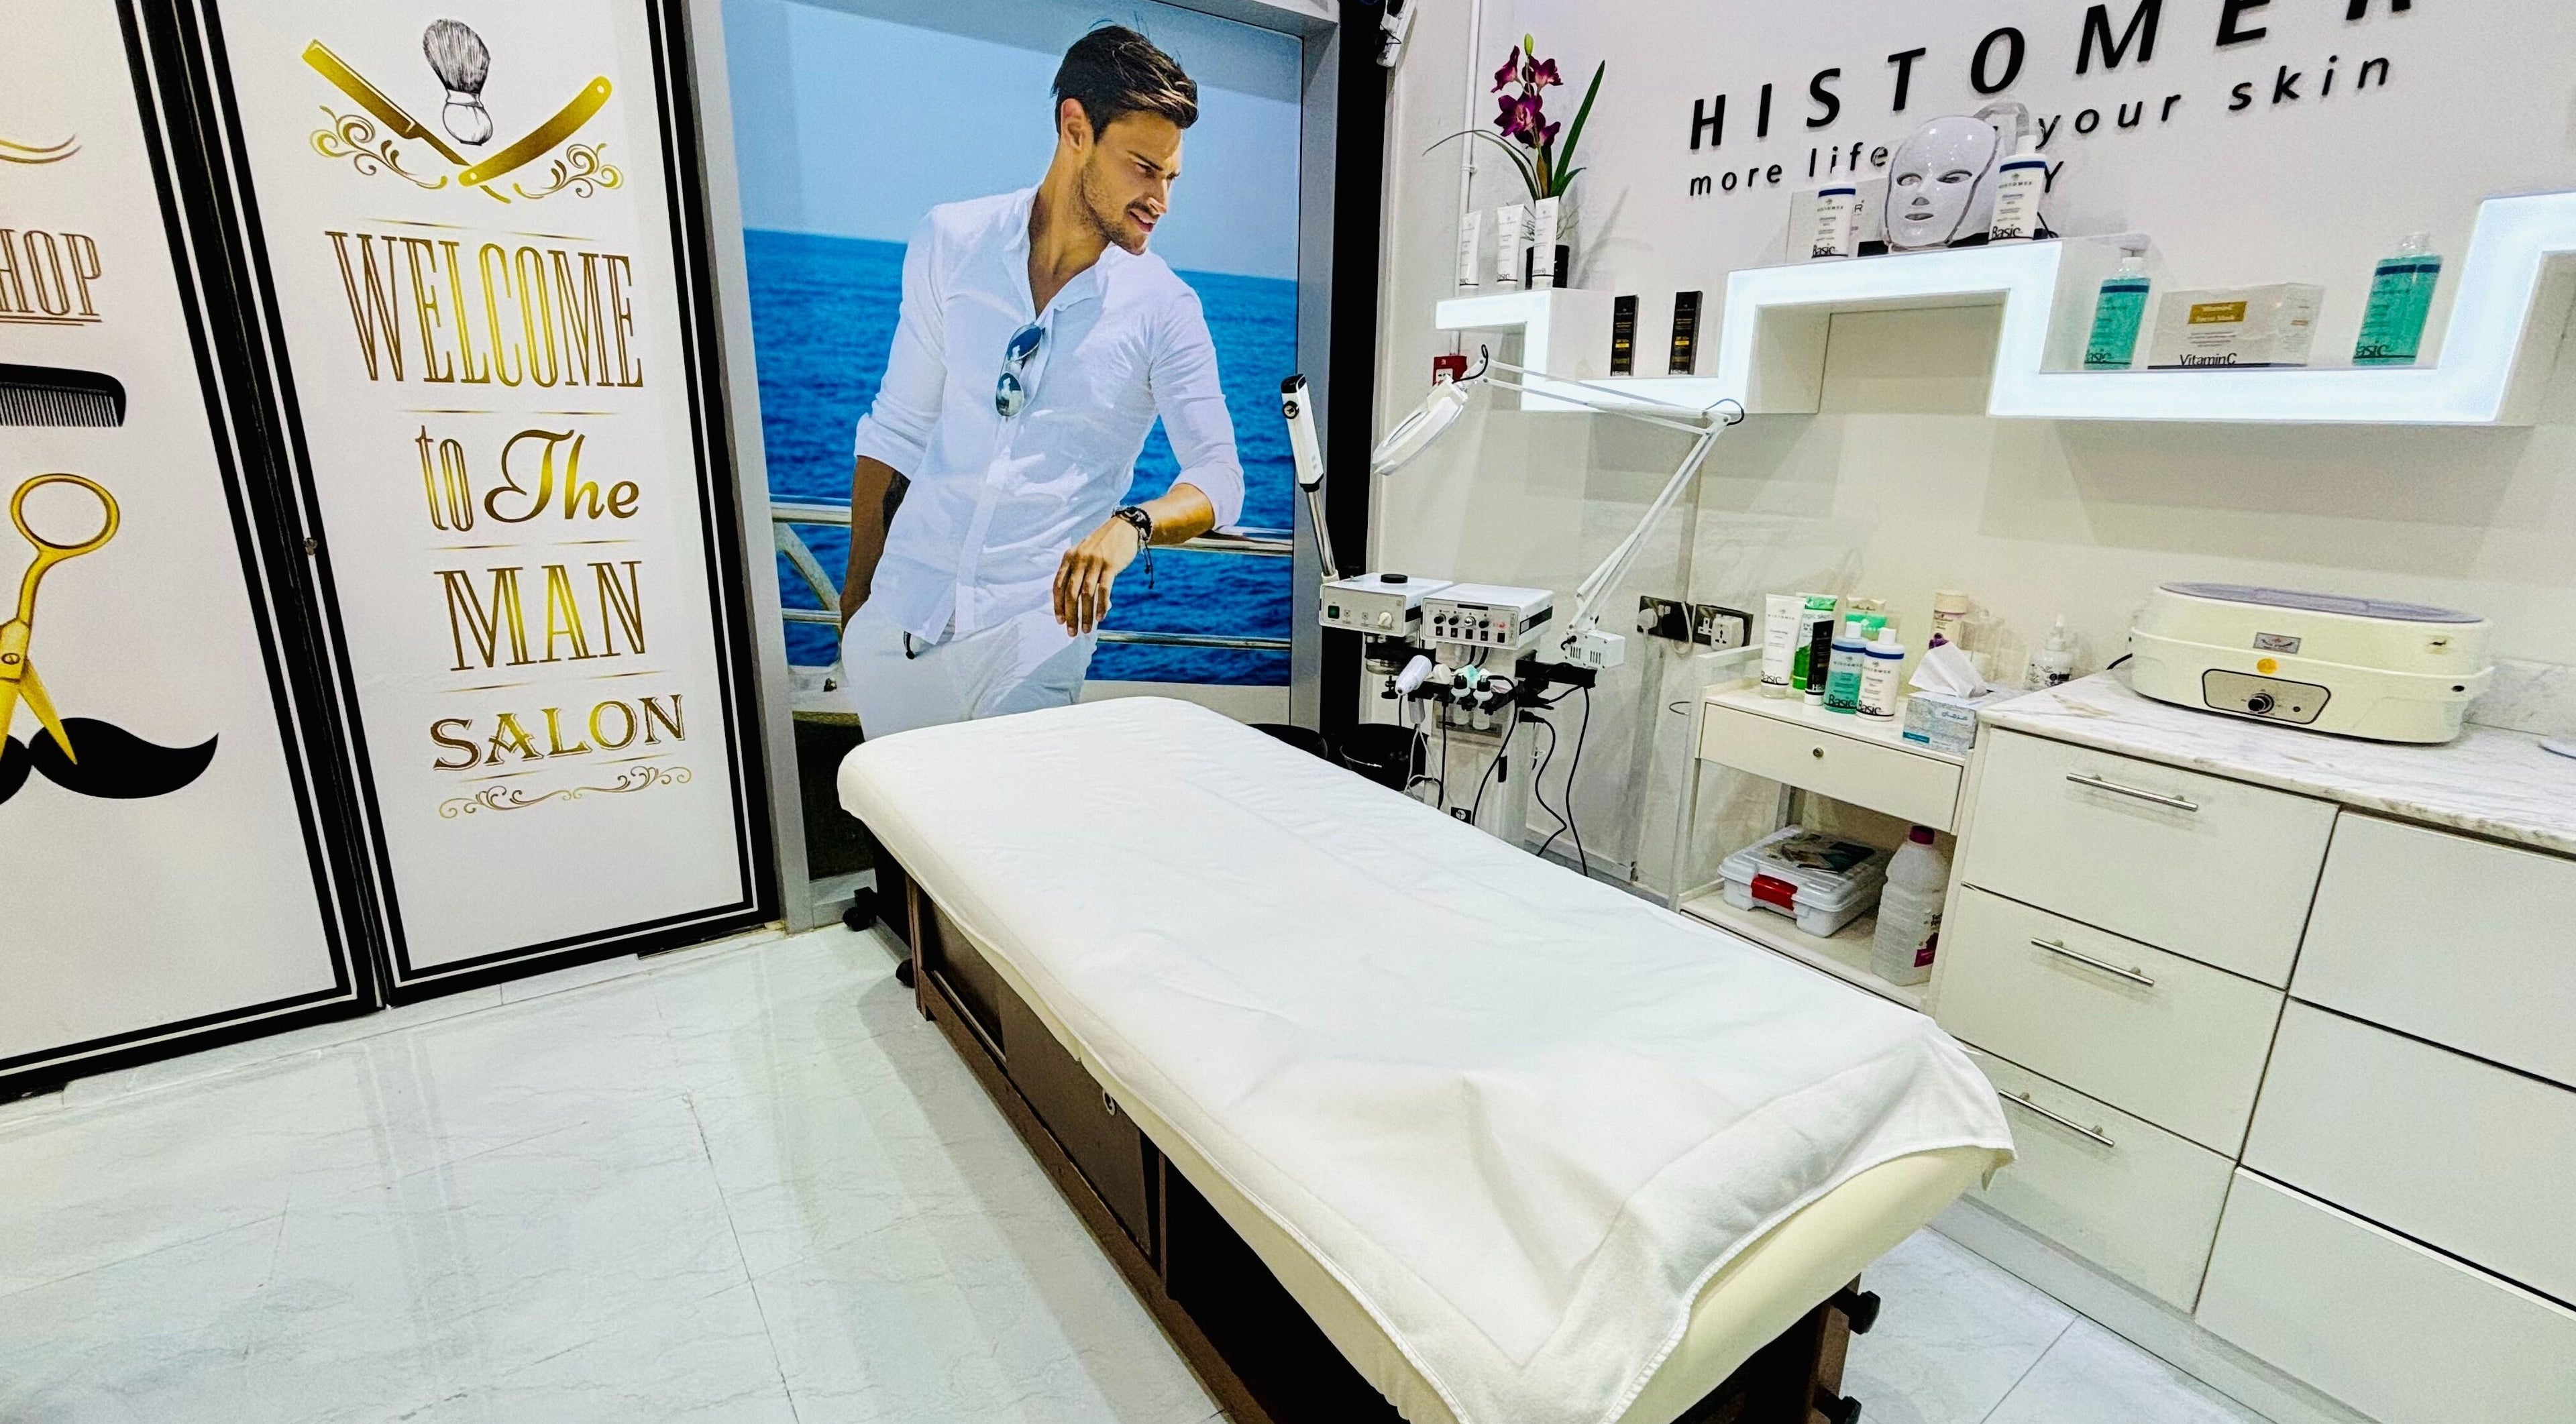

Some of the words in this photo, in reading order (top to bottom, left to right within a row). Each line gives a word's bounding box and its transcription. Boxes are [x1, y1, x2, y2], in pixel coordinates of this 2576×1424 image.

[1690, 0, 2411, 150] HISTOME
[1690, 164, 1782, 196] more
[1809, 142, 1888, 178] life
[2035, 94, 2181, 150] your
[2229, 55, 2390, 111] skin
[1813, 243, 1835, 256] Basic
[1992, 224, 2021, 238] Basic
[325, 231, 643, 388] WELCOME
[415, 425, 474, 531] to
[484, 429, 639, 523] The
[434, 561, 645, 671] MAN
[430, 694, 686, 771] SALON
[1829, 694, 1854, 708] Basic
[1859, 700, 1882, 716] Basic
